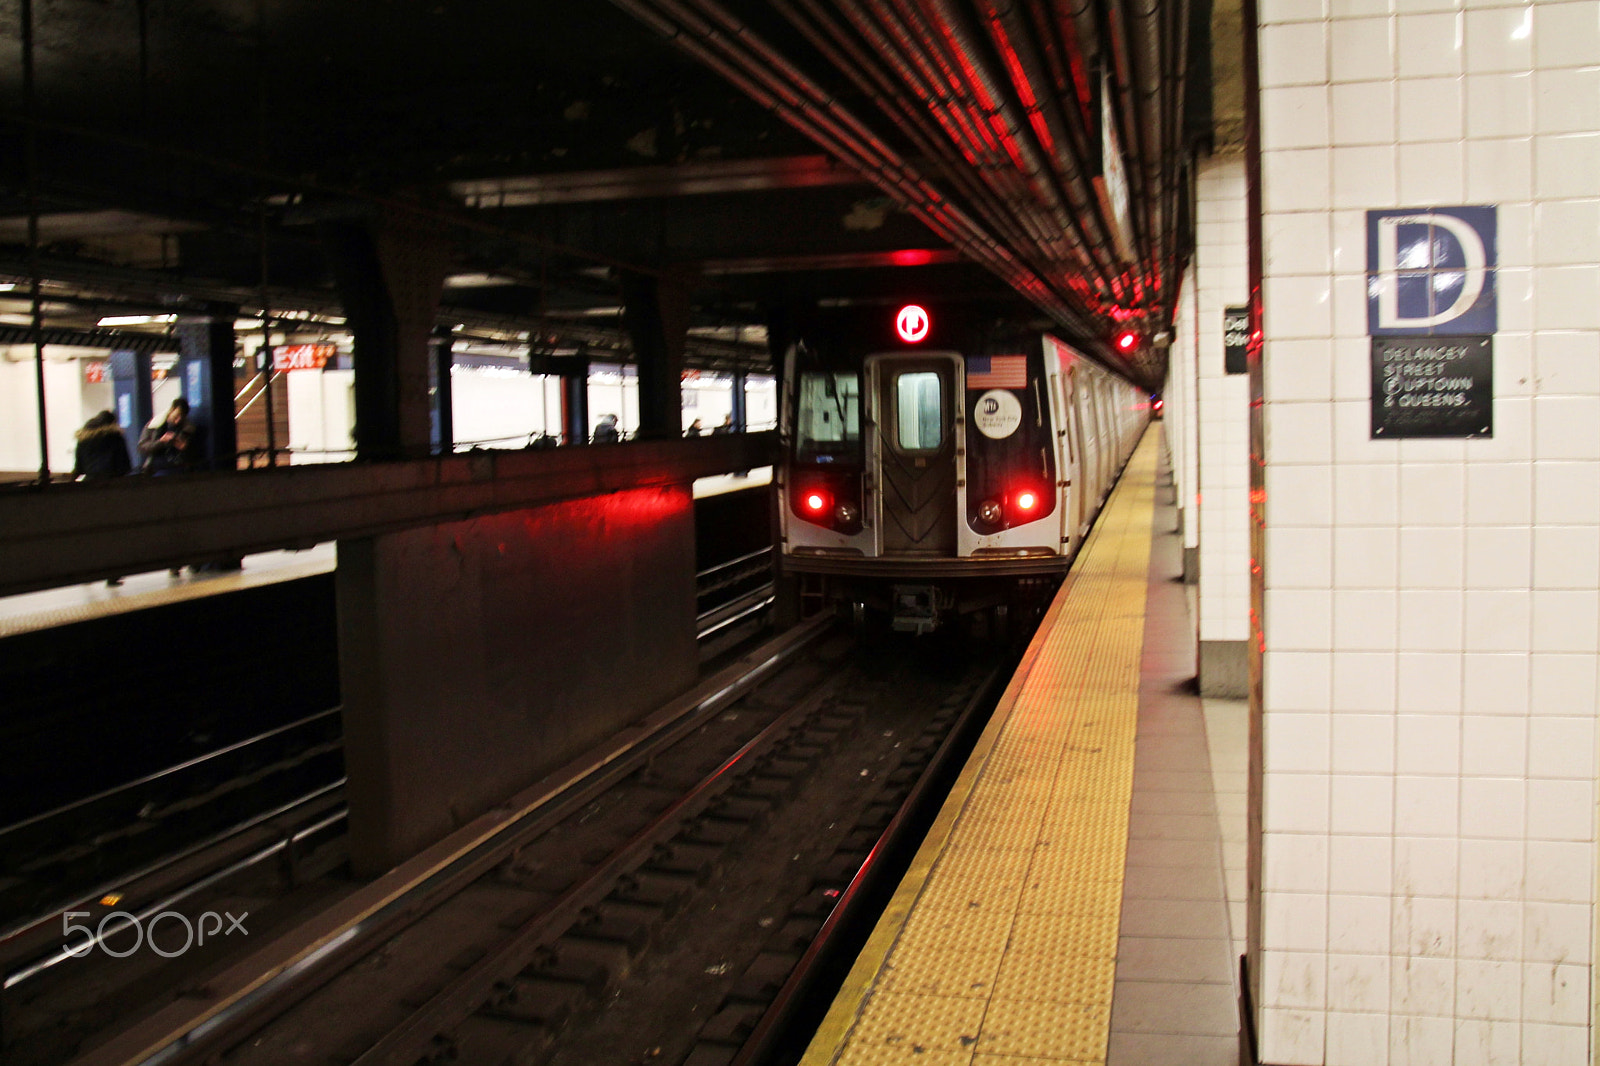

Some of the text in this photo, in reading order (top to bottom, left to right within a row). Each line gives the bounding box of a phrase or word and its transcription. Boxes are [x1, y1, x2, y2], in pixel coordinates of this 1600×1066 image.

[1378, 213, 1486, 329] D
[1383, 346, 1469, 362] DELANCEY
[1383, 362, 1447, 377] STREET
[1404, 376, 1473, 392] UPTOWN
